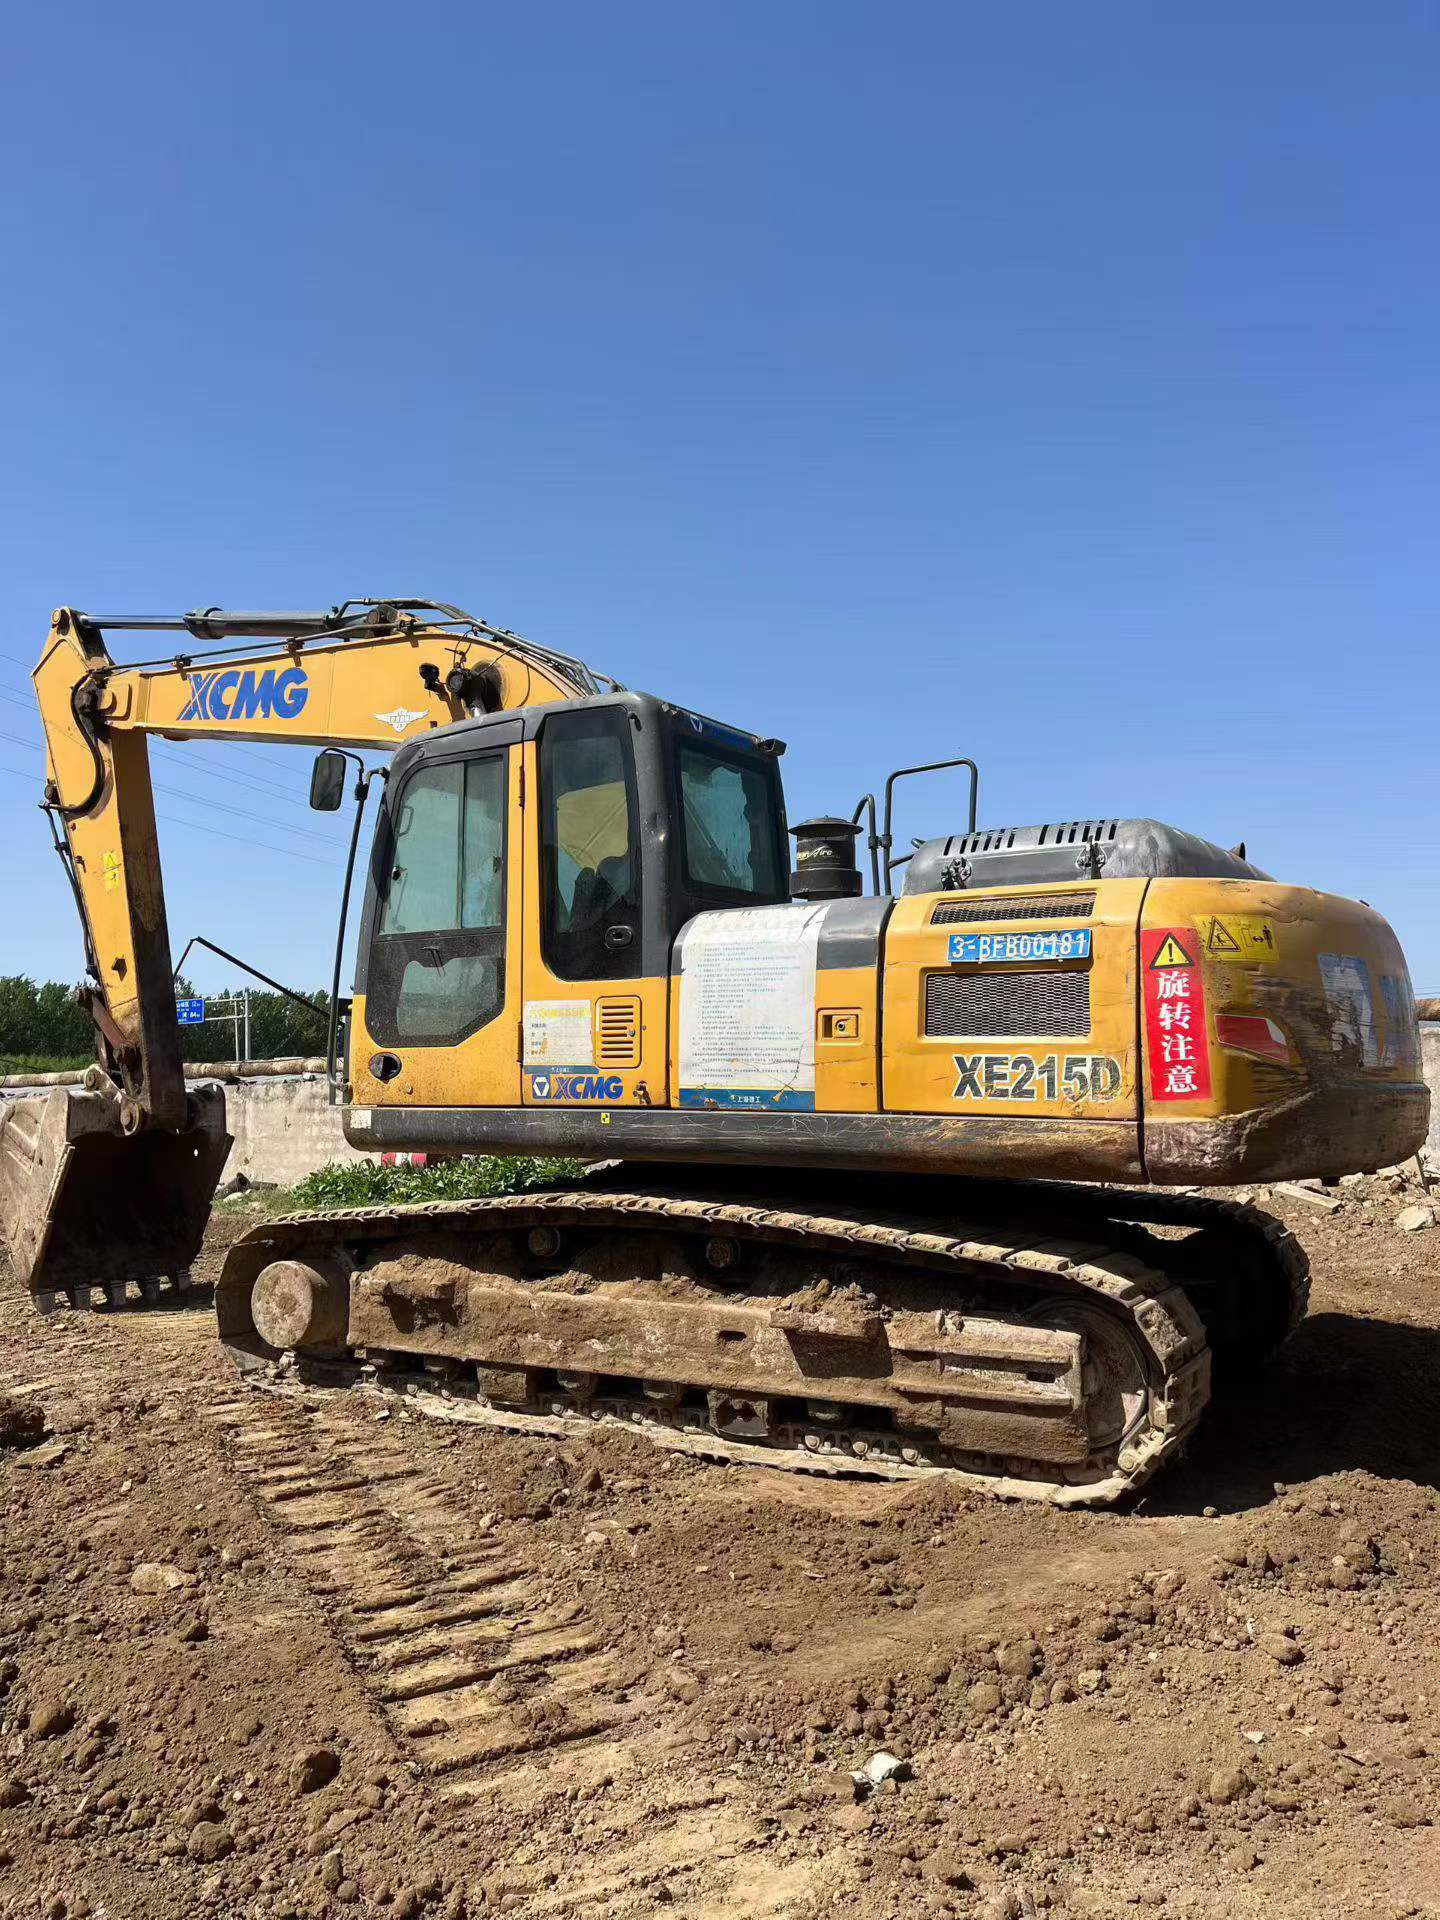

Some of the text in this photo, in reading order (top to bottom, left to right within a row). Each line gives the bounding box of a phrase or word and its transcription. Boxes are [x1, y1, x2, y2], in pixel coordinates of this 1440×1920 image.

[176, 667, 309, 721] XCMG
[1155, 971, 1198, 1093] 旋转注意
[552, 1076, 624, 1100] XCMG
[952, 1053, 1123, 1101] XE215D
